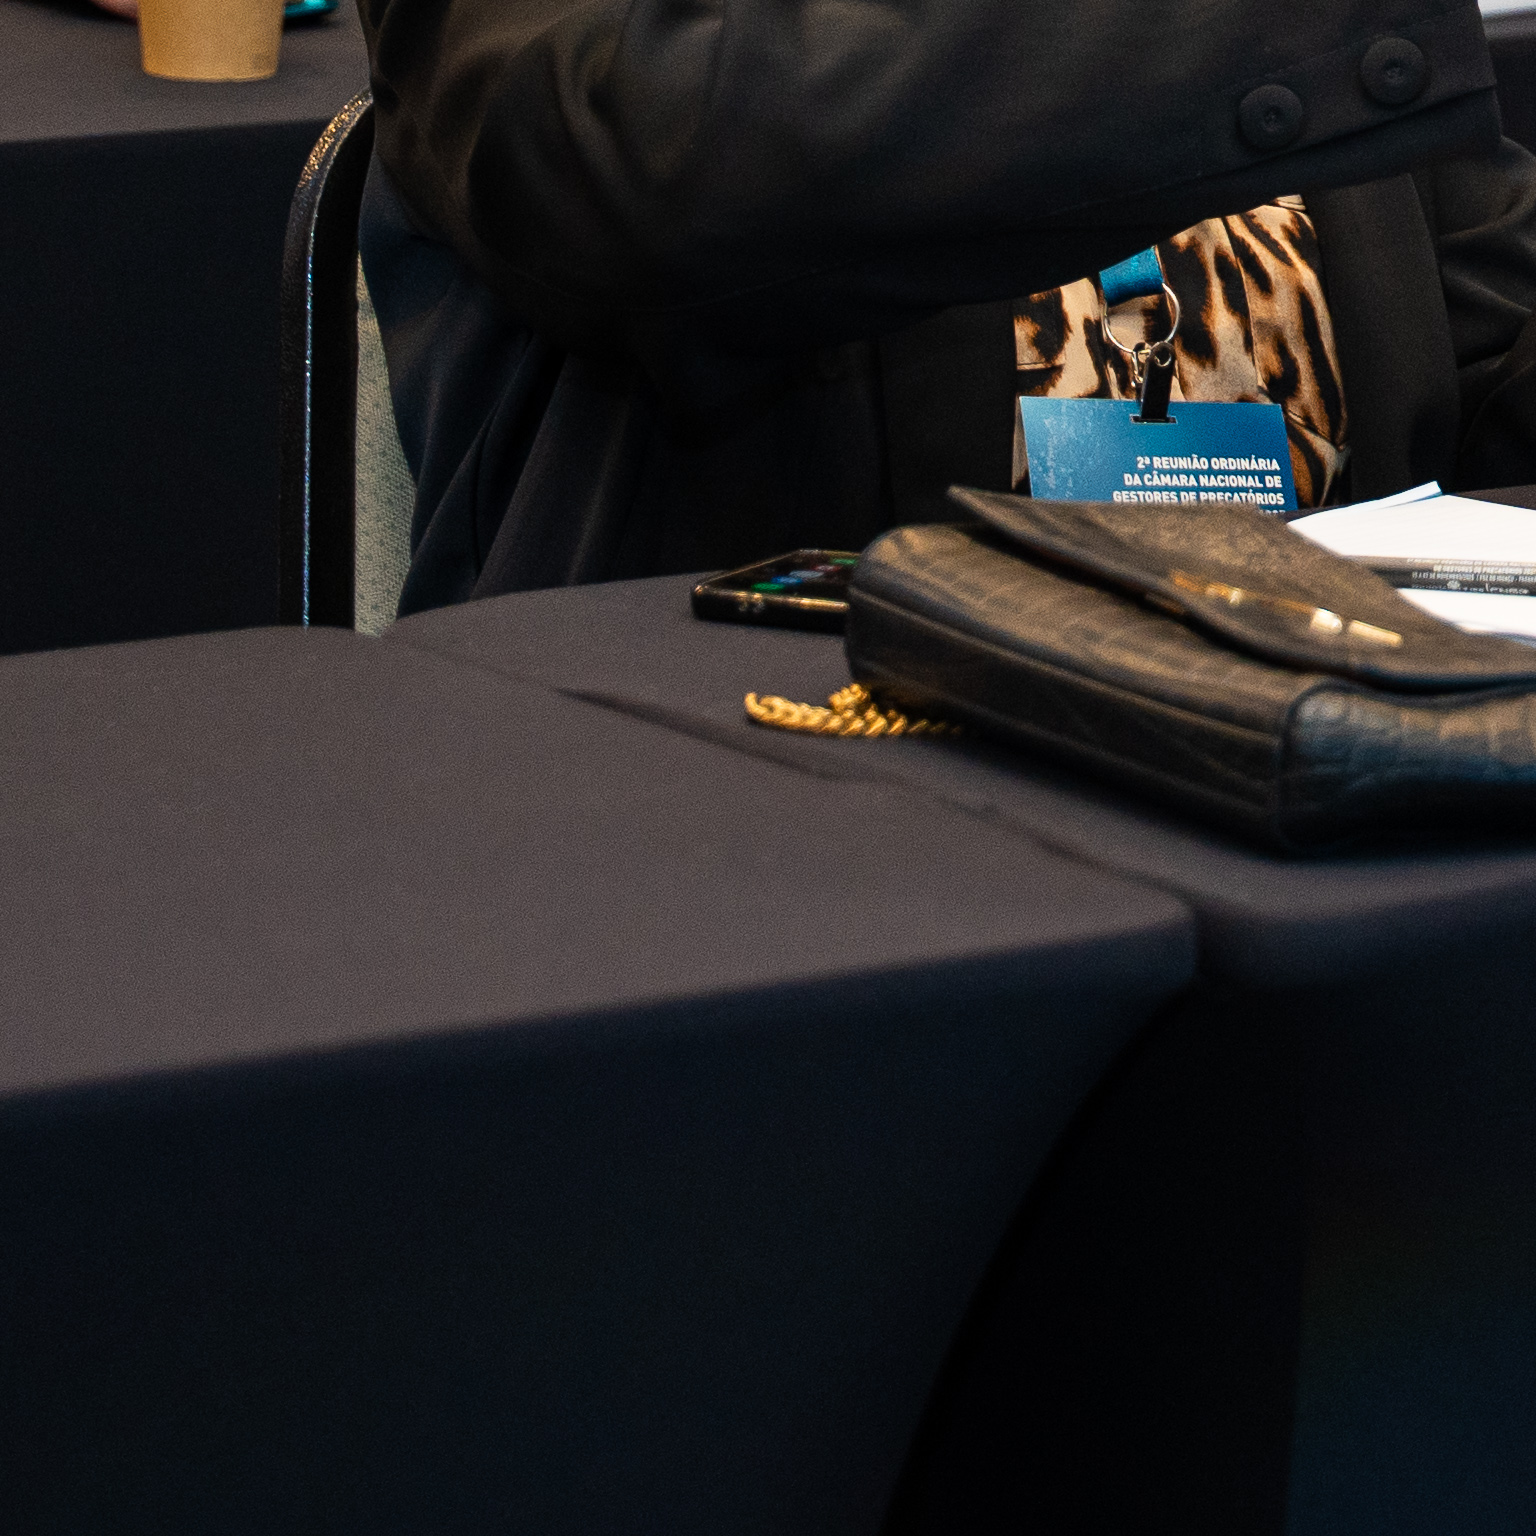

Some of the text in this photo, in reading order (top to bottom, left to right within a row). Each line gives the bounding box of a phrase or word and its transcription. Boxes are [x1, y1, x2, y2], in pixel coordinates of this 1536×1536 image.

[1136, 453, 1281, 471] 2ª REUNIÃO ORDINÁRIA
[1123, 470, 1283, 488] DA CÂMARA NACIONAL DE
[1112, 488, 1286, 505] GESTORES DE PRECATÓRIOS
